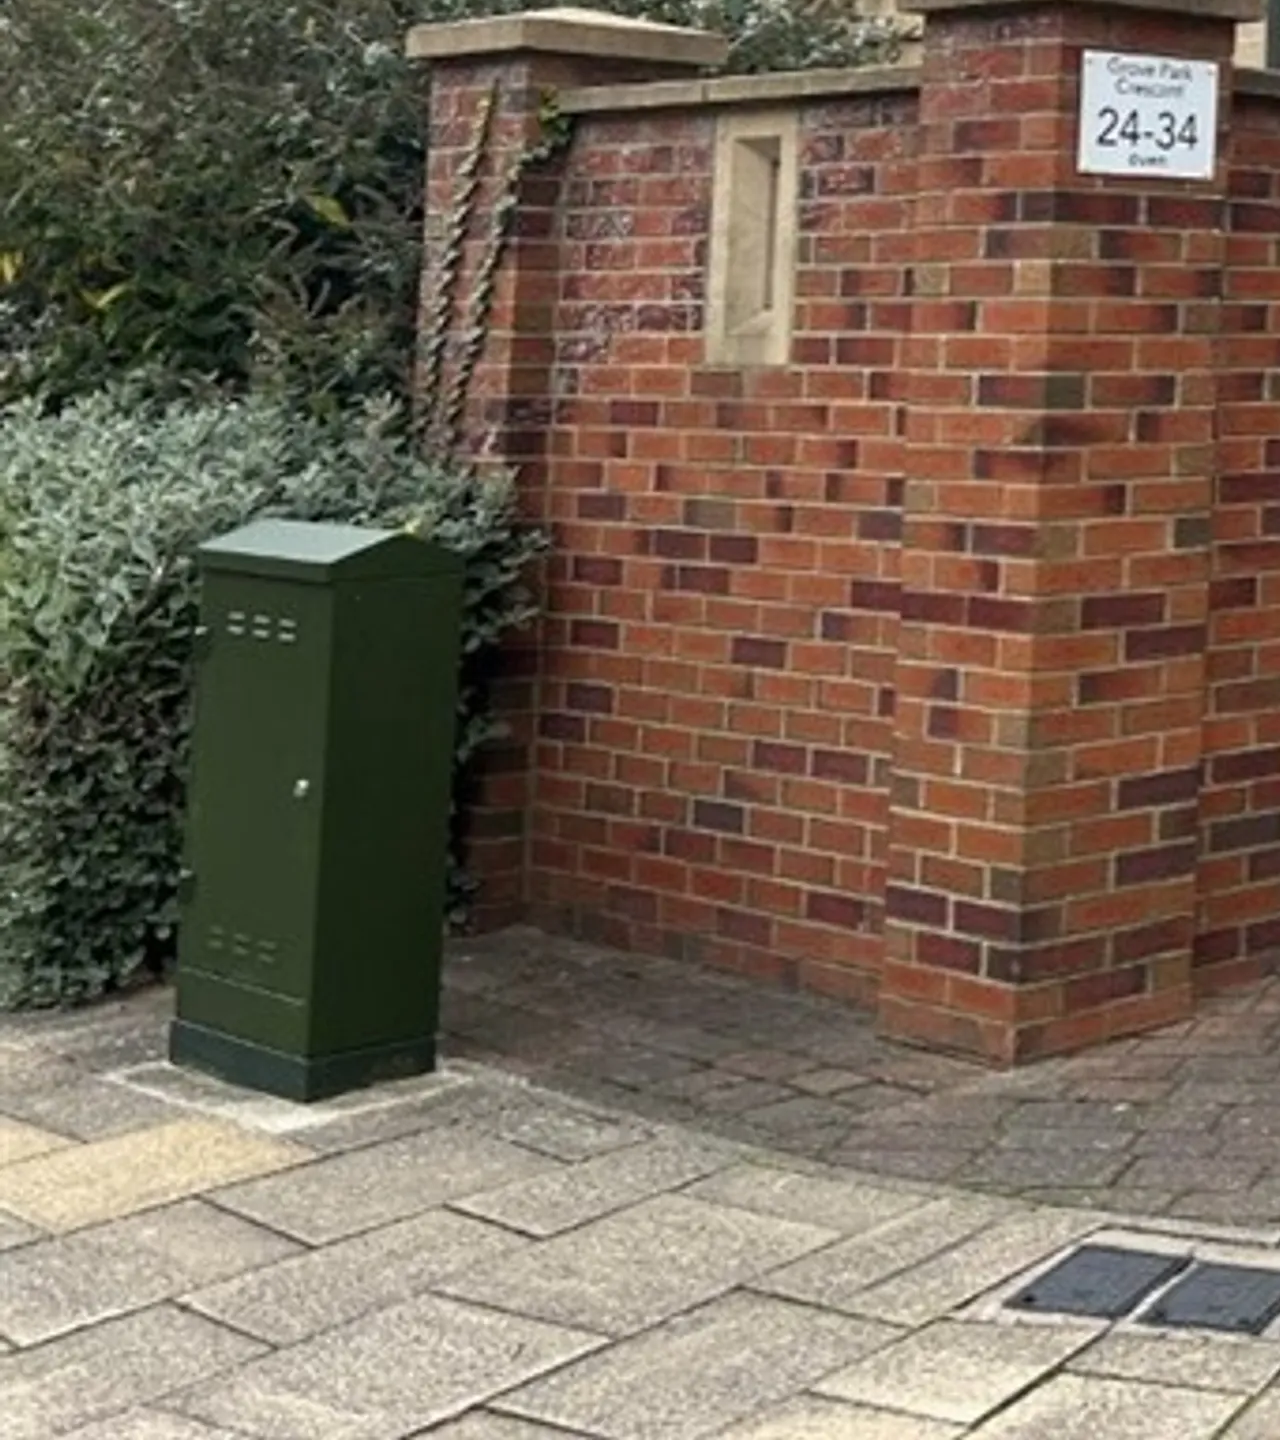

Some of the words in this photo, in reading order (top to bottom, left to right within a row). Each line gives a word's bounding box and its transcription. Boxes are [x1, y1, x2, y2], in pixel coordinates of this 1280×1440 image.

[1107, 56, 1155, 77] Grove
[1159, 63, 1192, 80] Park
[1114, 77, 1183, 97] Crescent
[1096, 105, 1197, 151] 24-34
[1128, 154, 1167, 166] even
